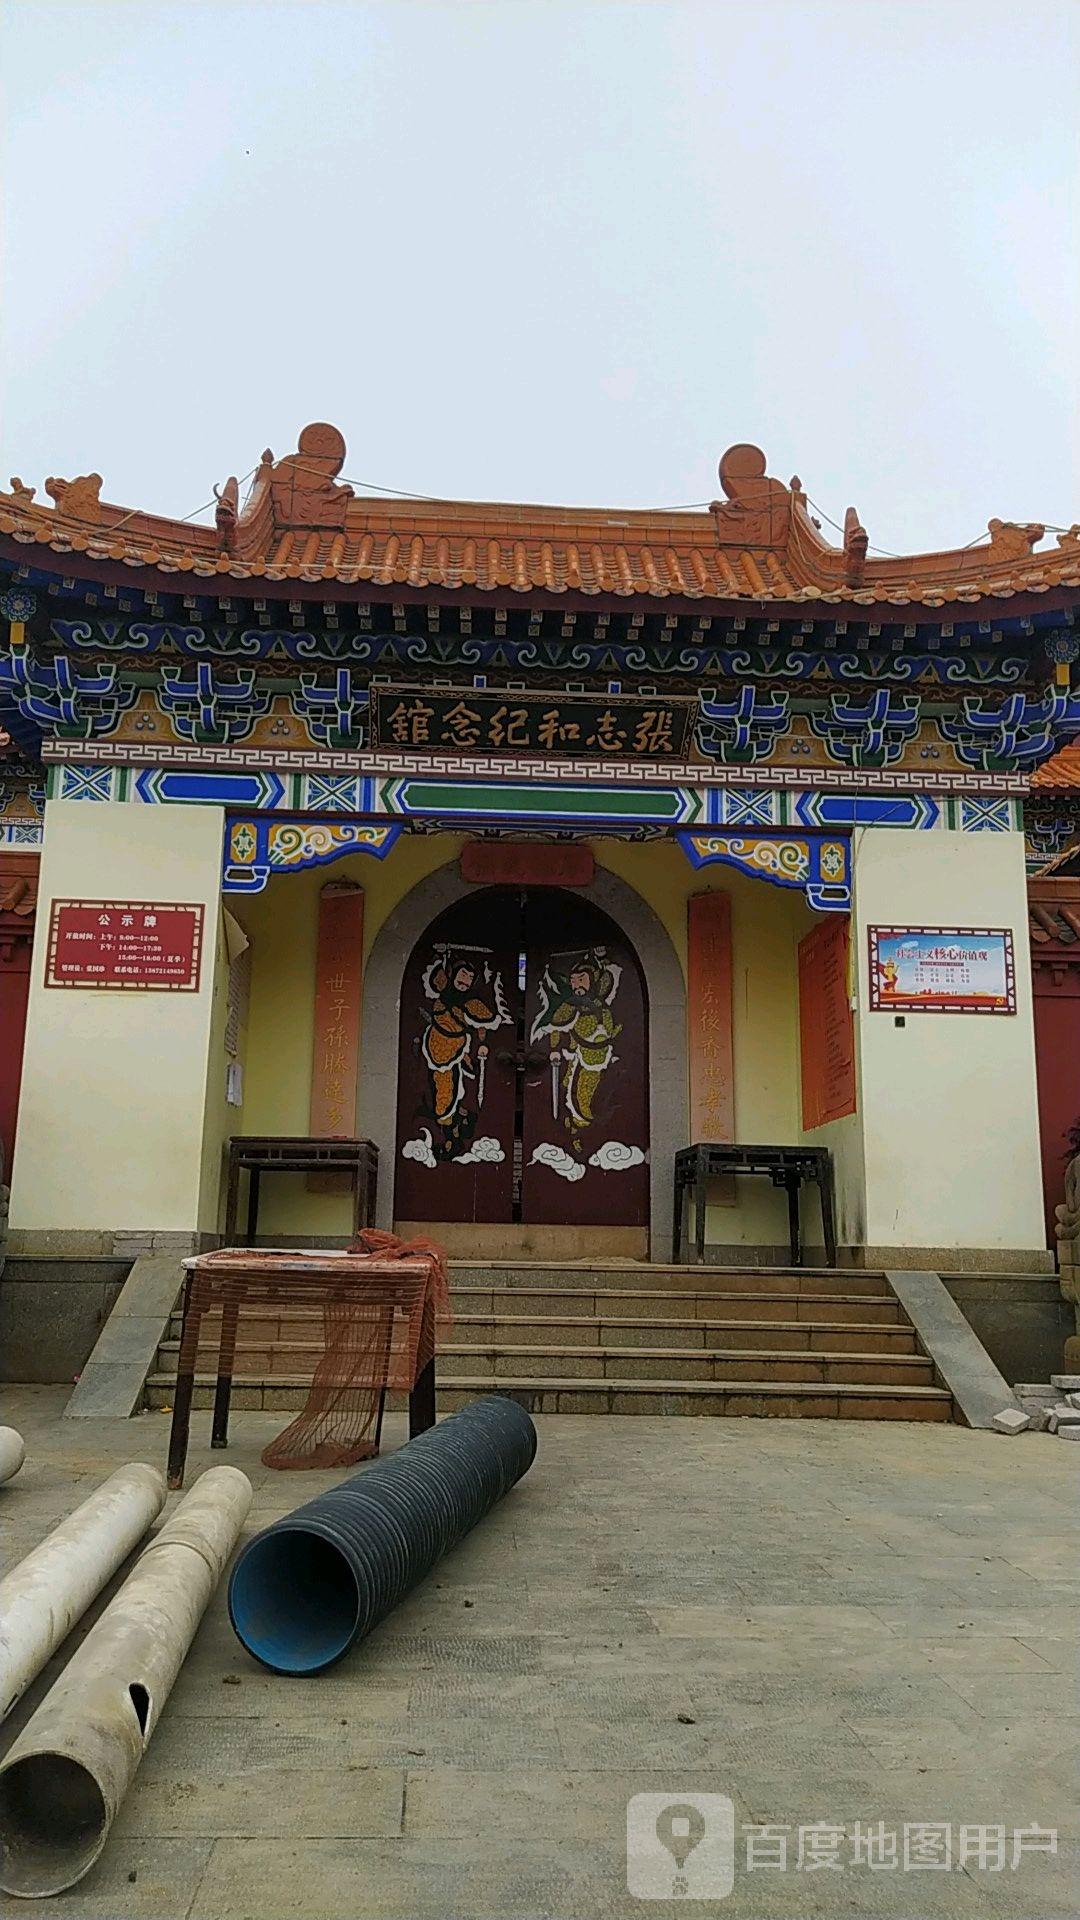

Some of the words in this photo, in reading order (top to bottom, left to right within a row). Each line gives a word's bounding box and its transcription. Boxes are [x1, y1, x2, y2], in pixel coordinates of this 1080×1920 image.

[98, 914, 157, 928] 公示牌
[896, 948, 988, 961] 社会主义核心价值观
